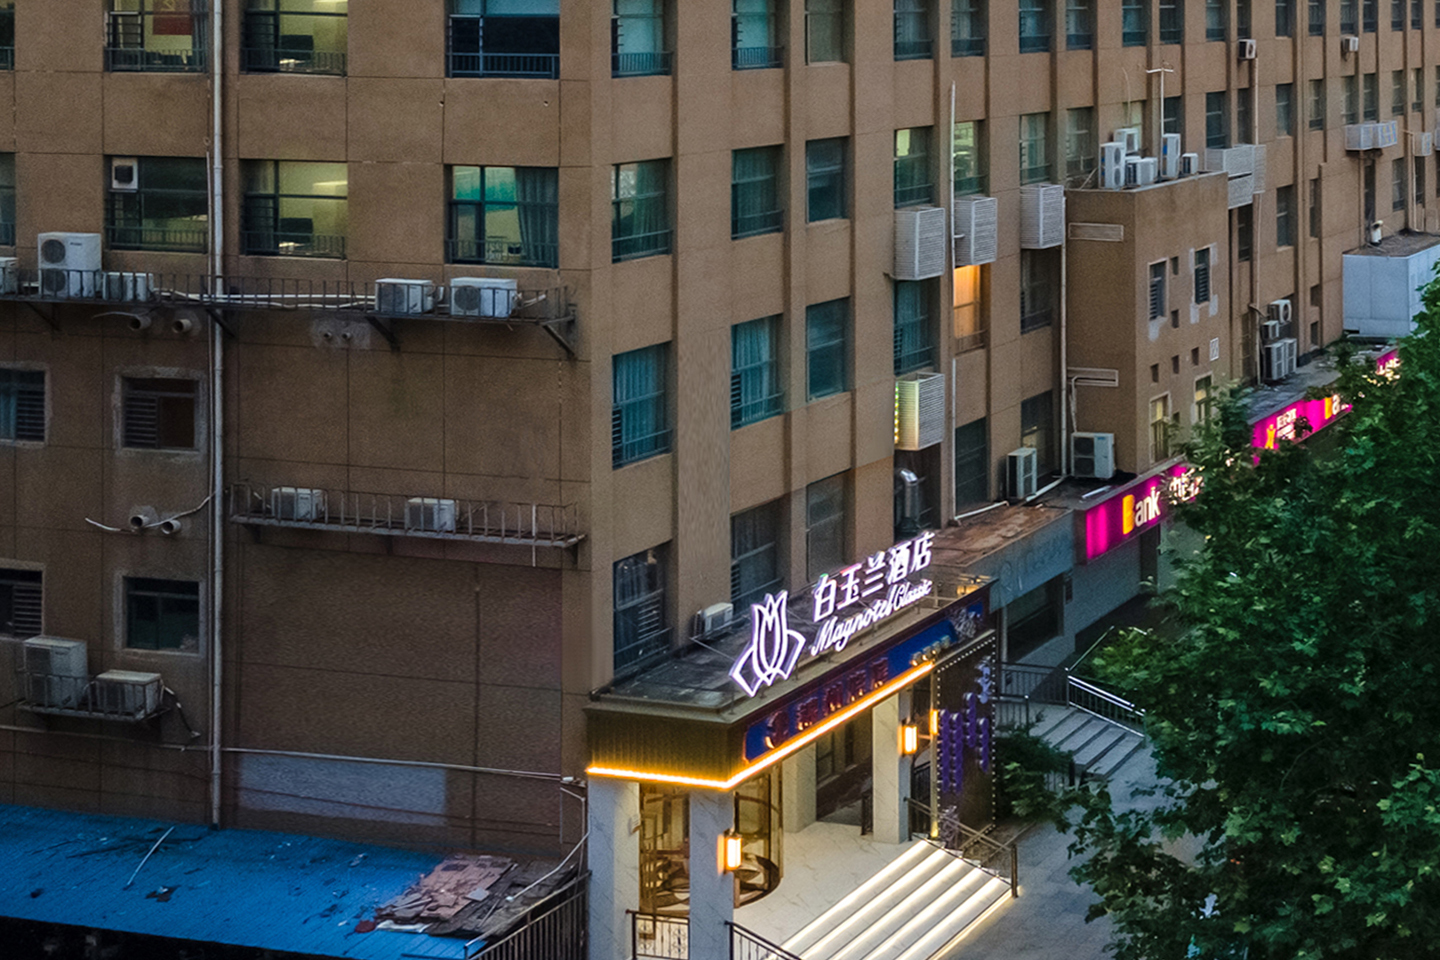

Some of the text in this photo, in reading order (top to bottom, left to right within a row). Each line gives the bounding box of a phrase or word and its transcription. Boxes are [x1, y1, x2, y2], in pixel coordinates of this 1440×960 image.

[1122, 486, 1162, 535] Bank
[813, 530, 936, 623] 白玉兰酒店
[810, 583, 897, 656] Magnotel
